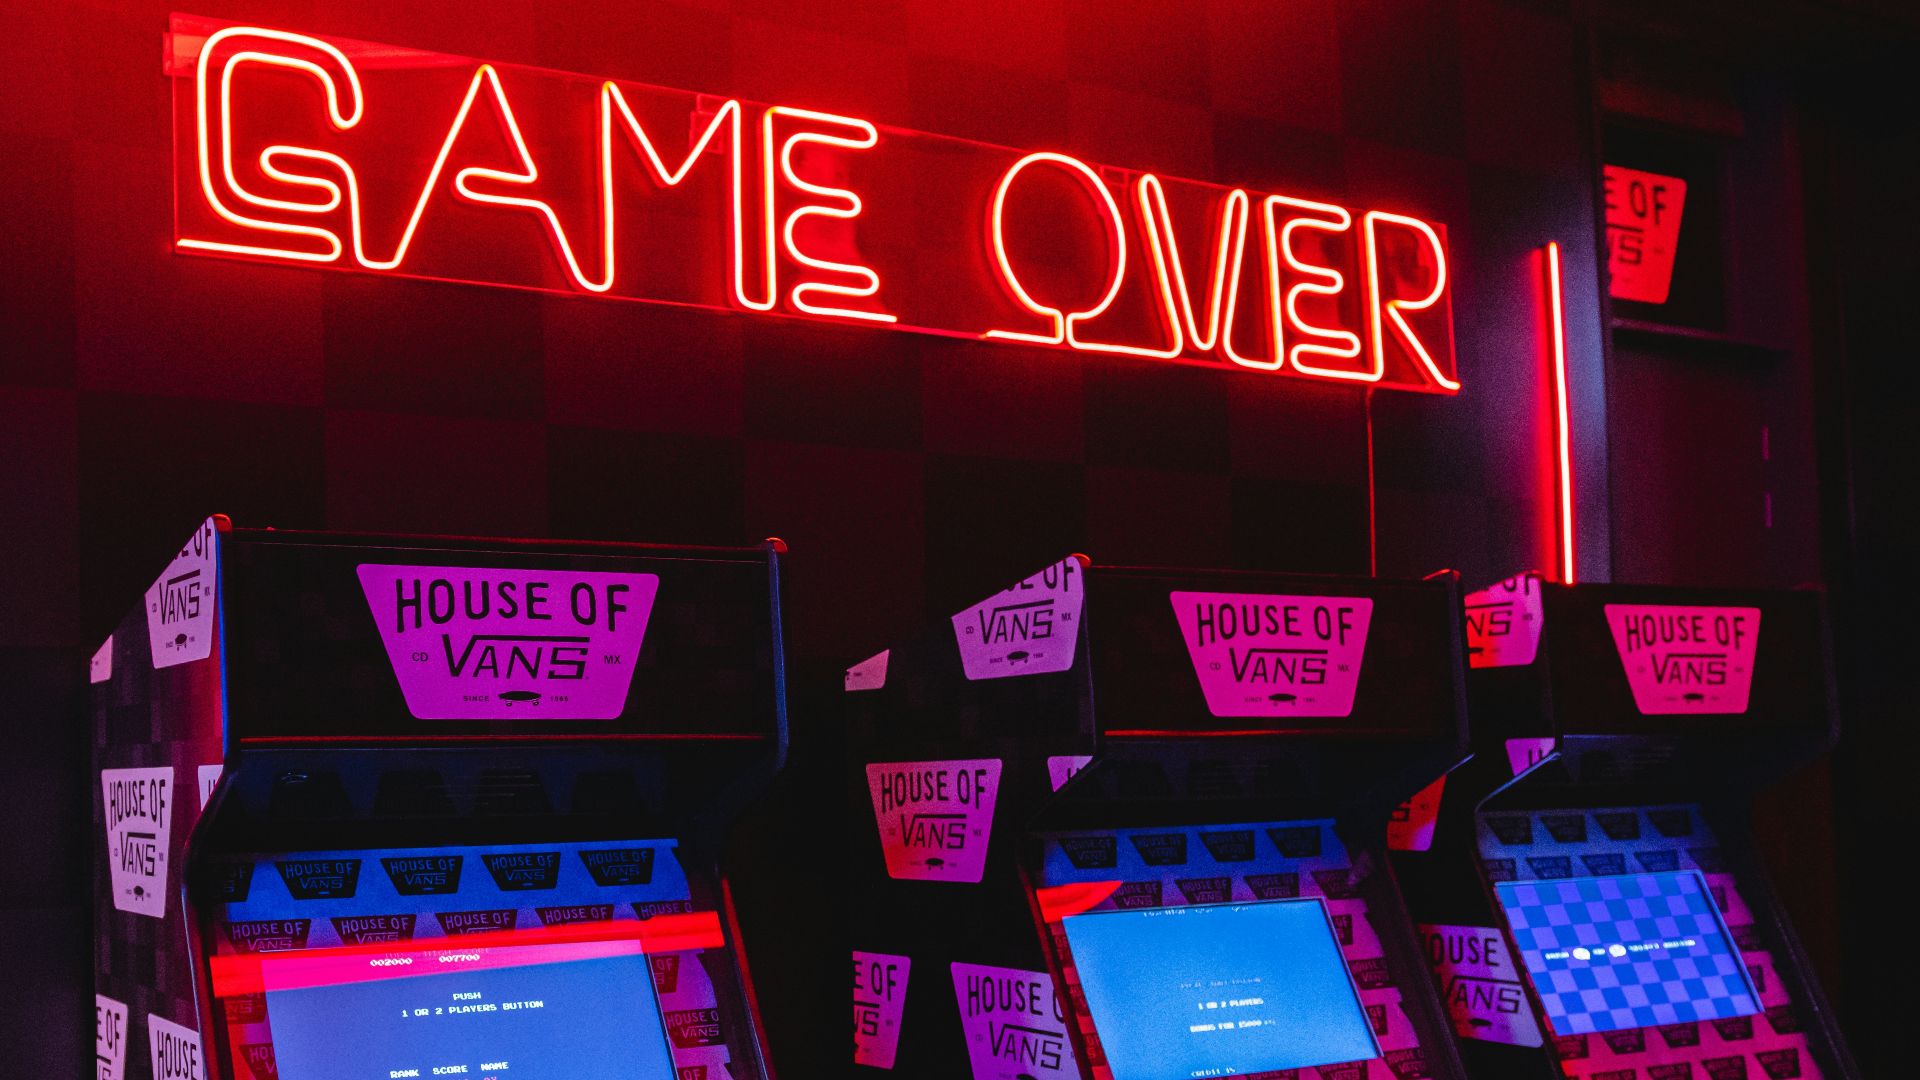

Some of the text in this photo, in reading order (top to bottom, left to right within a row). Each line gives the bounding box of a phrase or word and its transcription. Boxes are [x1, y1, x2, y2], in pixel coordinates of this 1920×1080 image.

[176, 25, 1461, 390] GAME OVER
[1630, 180, 1666, 225] OF
[159, 569, 201, 625] VANS
[395, 578, 630, 633] HOUSE OF
[979, 598, 1055, 645] VANS
[1196, 603, 1354, 647] HOUSE OF
[1465, 601, 1513, 637] NS
[1625, 614, 1745, 653] HOUSE OF
[411, 633, 621, 680] CD VANS MX
[1229, 647, 1328, 685] VANS
[1651, 653, 1727, 685] VANS
[109, 780, 147, 831] HOUSE
[149, 778, 166, 829] OF
[881, 768, 987, 814] HOUSE OF
[900, 813, 967, 850] VANS
[120, 831, 156, 877] VANS
[285, 862, 353, 879] HOUSE OF
[390, 858, 457, 876] HOUSE OF
[490, 853, 554, 872] HOUSE OF
[299, 875, 345, 890] VANS
[403, 872, 447, 887] VANS
[505, 869, 545, 882] VANS
[341, 916, 410, 934] HOUSE OF
[445, 911, 511, 930] HOUSE OF
[545, 905, 608, 925] HOUSE OF
[640, 900, 693, 919] HOUSE O
[232, 921, 304, 941] HOUSE OF
[247, 936, 293, 952] VANS
[369, 953, 480, 967] 002000 007700
[1424, 933, 1499, 967] OUSE
[452, 991, 482, 1001] PUSH
[871, 962, 897, 1002] OF
[967, 975, 1044, 1018] HOUSE
[402, 1000, 544, 1018] 1 OR 2 PLAYERS BUTTON
[665, 1009, 720, 1029] HOUSE O
[106, 1008, 120, 1058] OF
[681, 1023, 720, 1039] VANS
[988, 1020, 1064, 1071] VANS
[157, 1030, 197, 1080] HOUSE
[390, 1061, 509, 1079] RANK SCORE NAME
